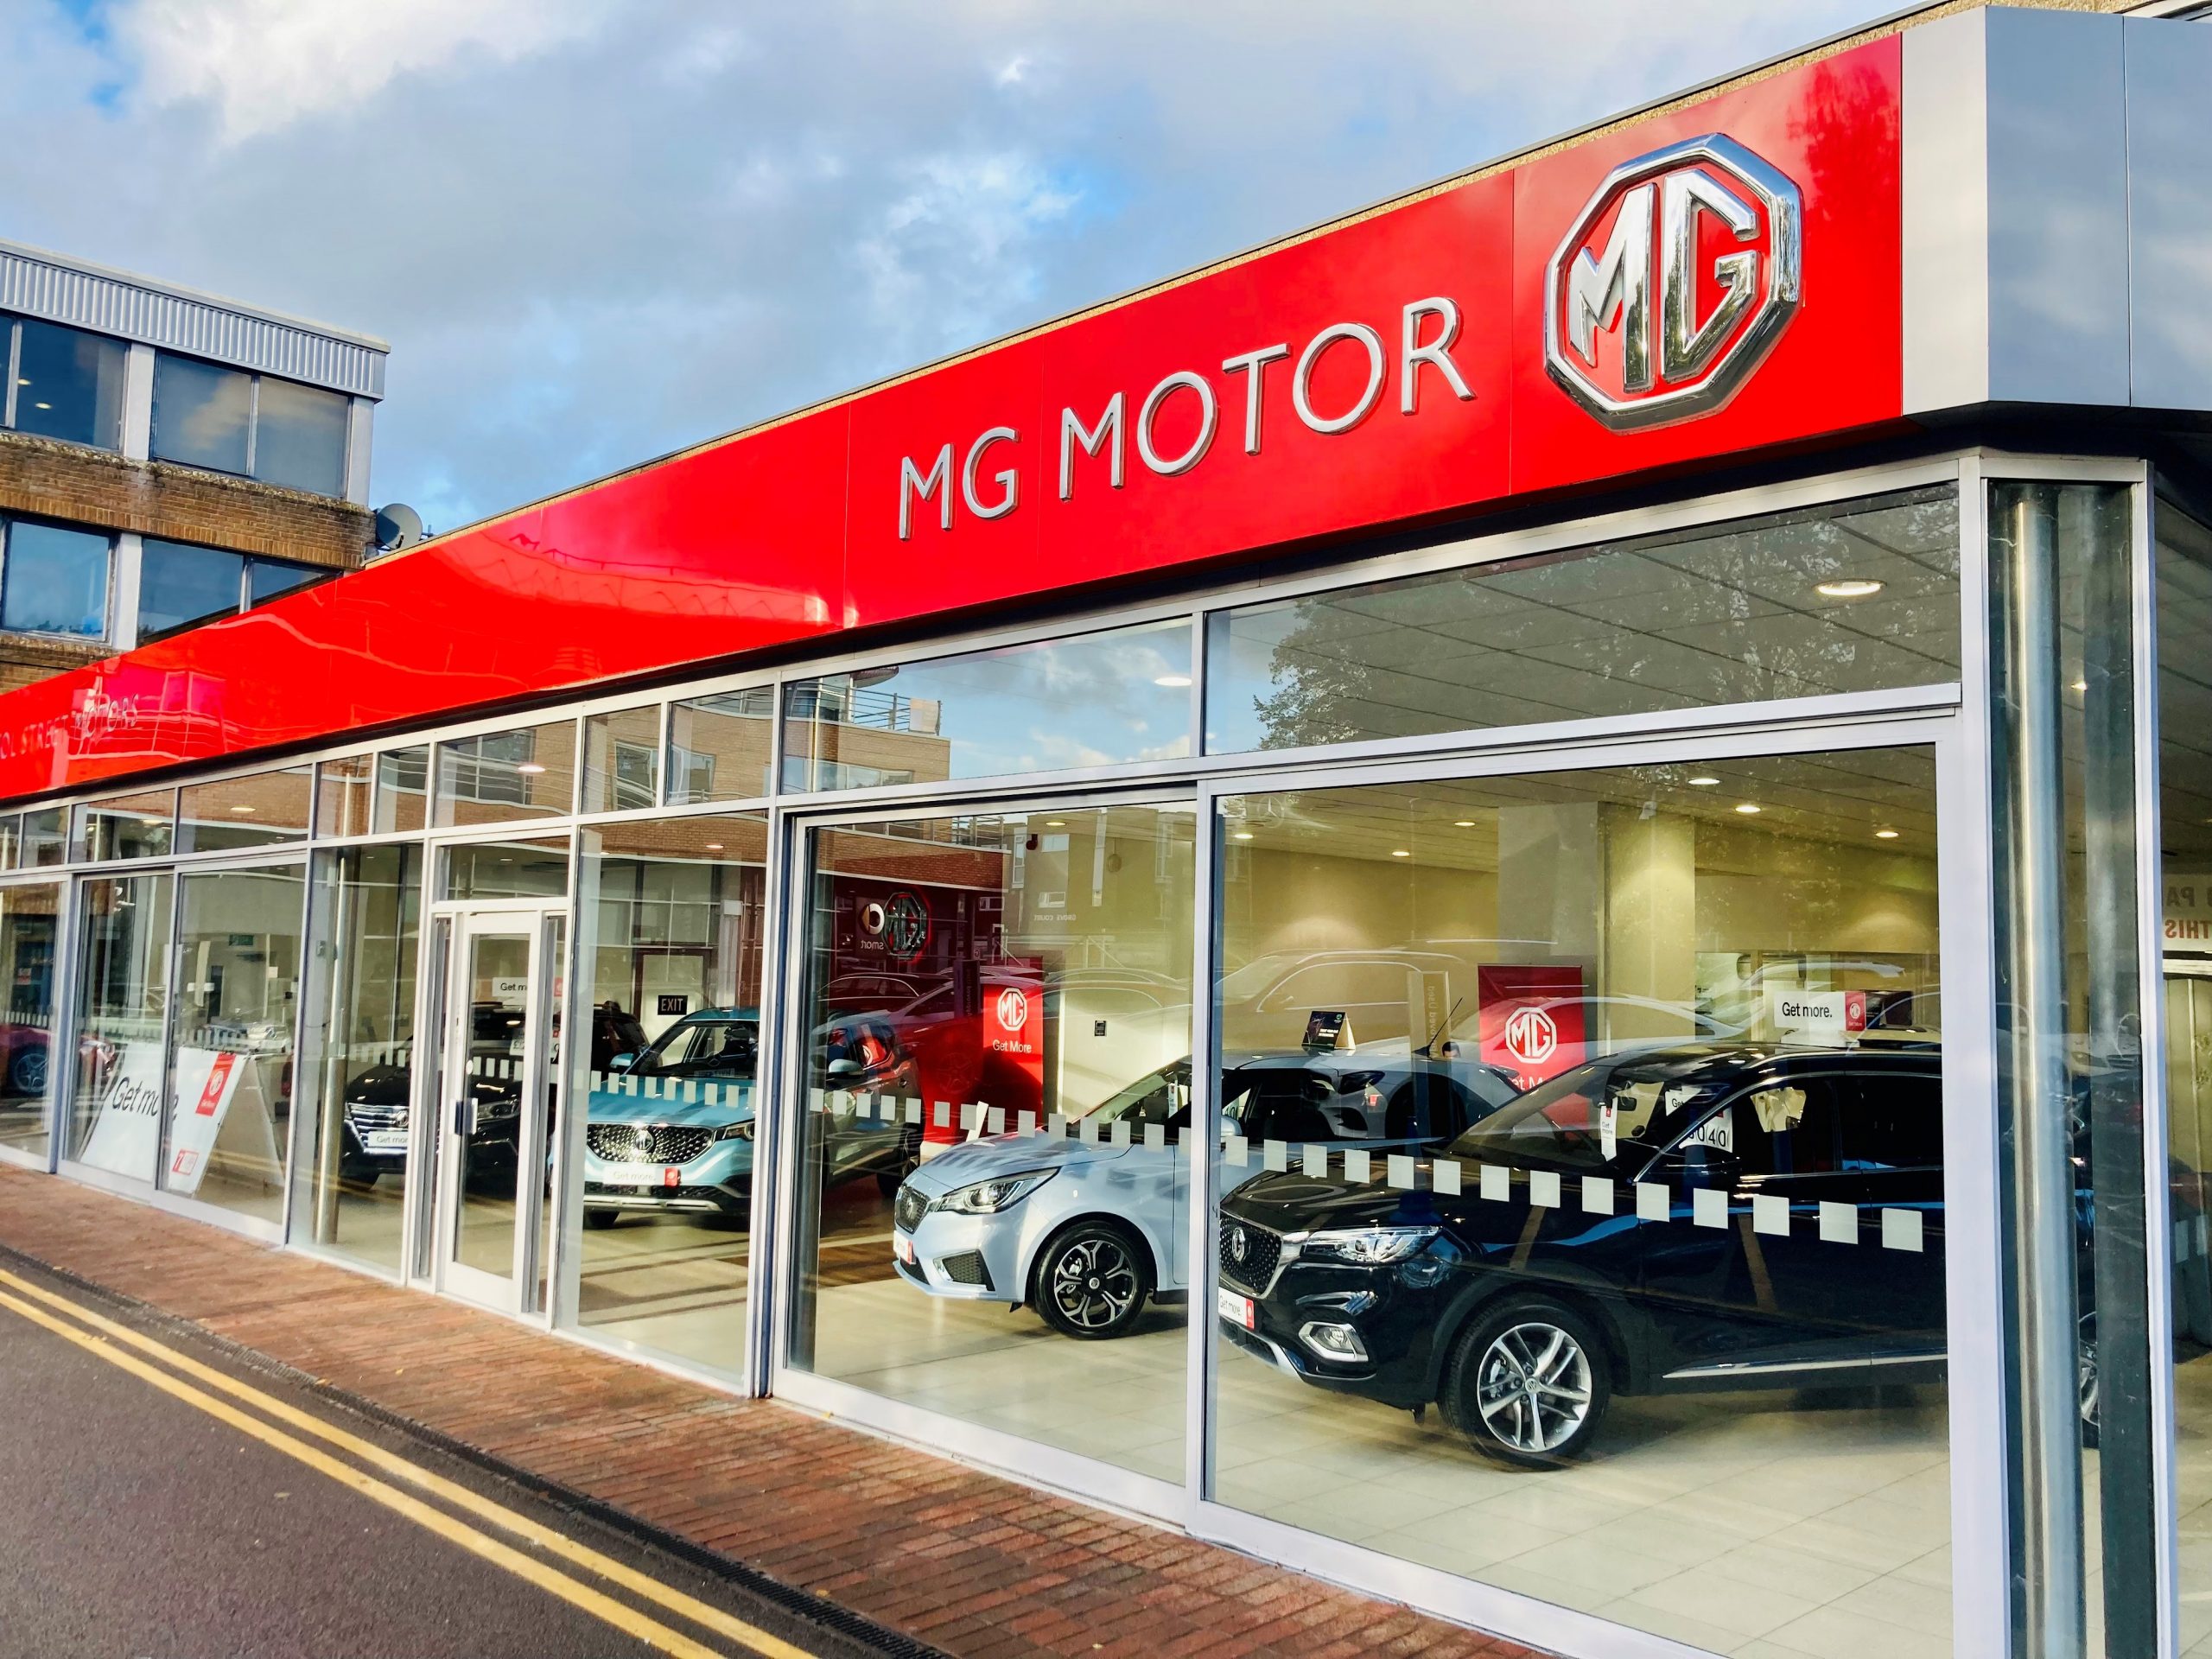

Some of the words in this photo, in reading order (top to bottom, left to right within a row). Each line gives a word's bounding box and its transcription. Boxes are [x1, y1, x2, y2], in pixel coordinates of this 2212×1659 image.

[1564, 164, 1767, 397] MG
[899, 426, 1021, 542] MG
[1058, 296, 1476, 502] MOTOR
[661, 998, 683, 1011] EXIT
[1001, 991, 1025, 1027] MG
[1782, 1001, 1801, 1017] Get
[1802, 1006, 1833, 1018] more.
[993, 1039, 1007, 1051] Get
[1010, 1039, 1032, 1052] More
[1510, 1012, 1552, 1057] MG
[112, 1077, 143, 1113] Get
[1511, 1077, 1526, 1090] et
